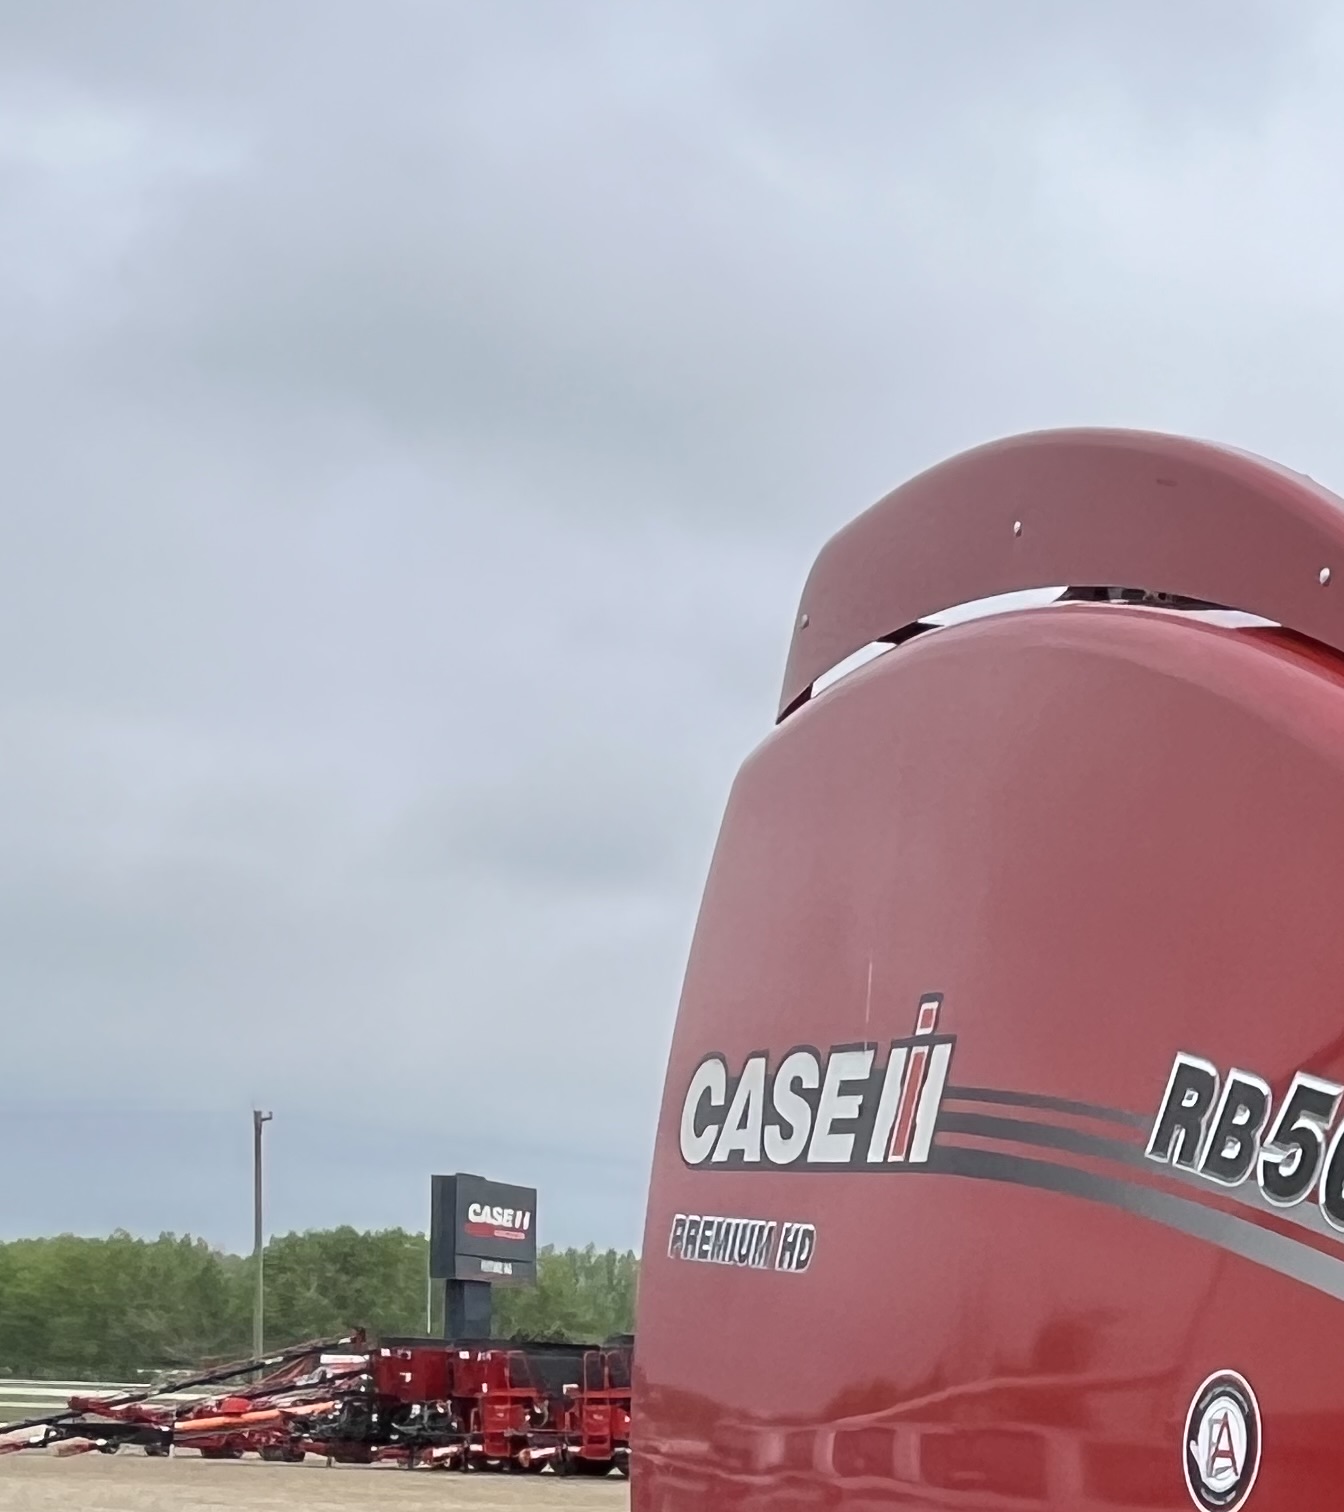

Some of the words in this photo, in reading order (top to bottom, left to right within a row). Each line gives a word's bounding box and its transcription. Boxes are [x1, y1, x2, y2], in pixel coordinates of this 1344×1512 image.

[679, 1049, 876, 1166] CASE
[467, 1202, 515, 1228] CASE
[667, 1213, 778, 1270] PREMIUM
[774, 1221, 817, 1274] HD
